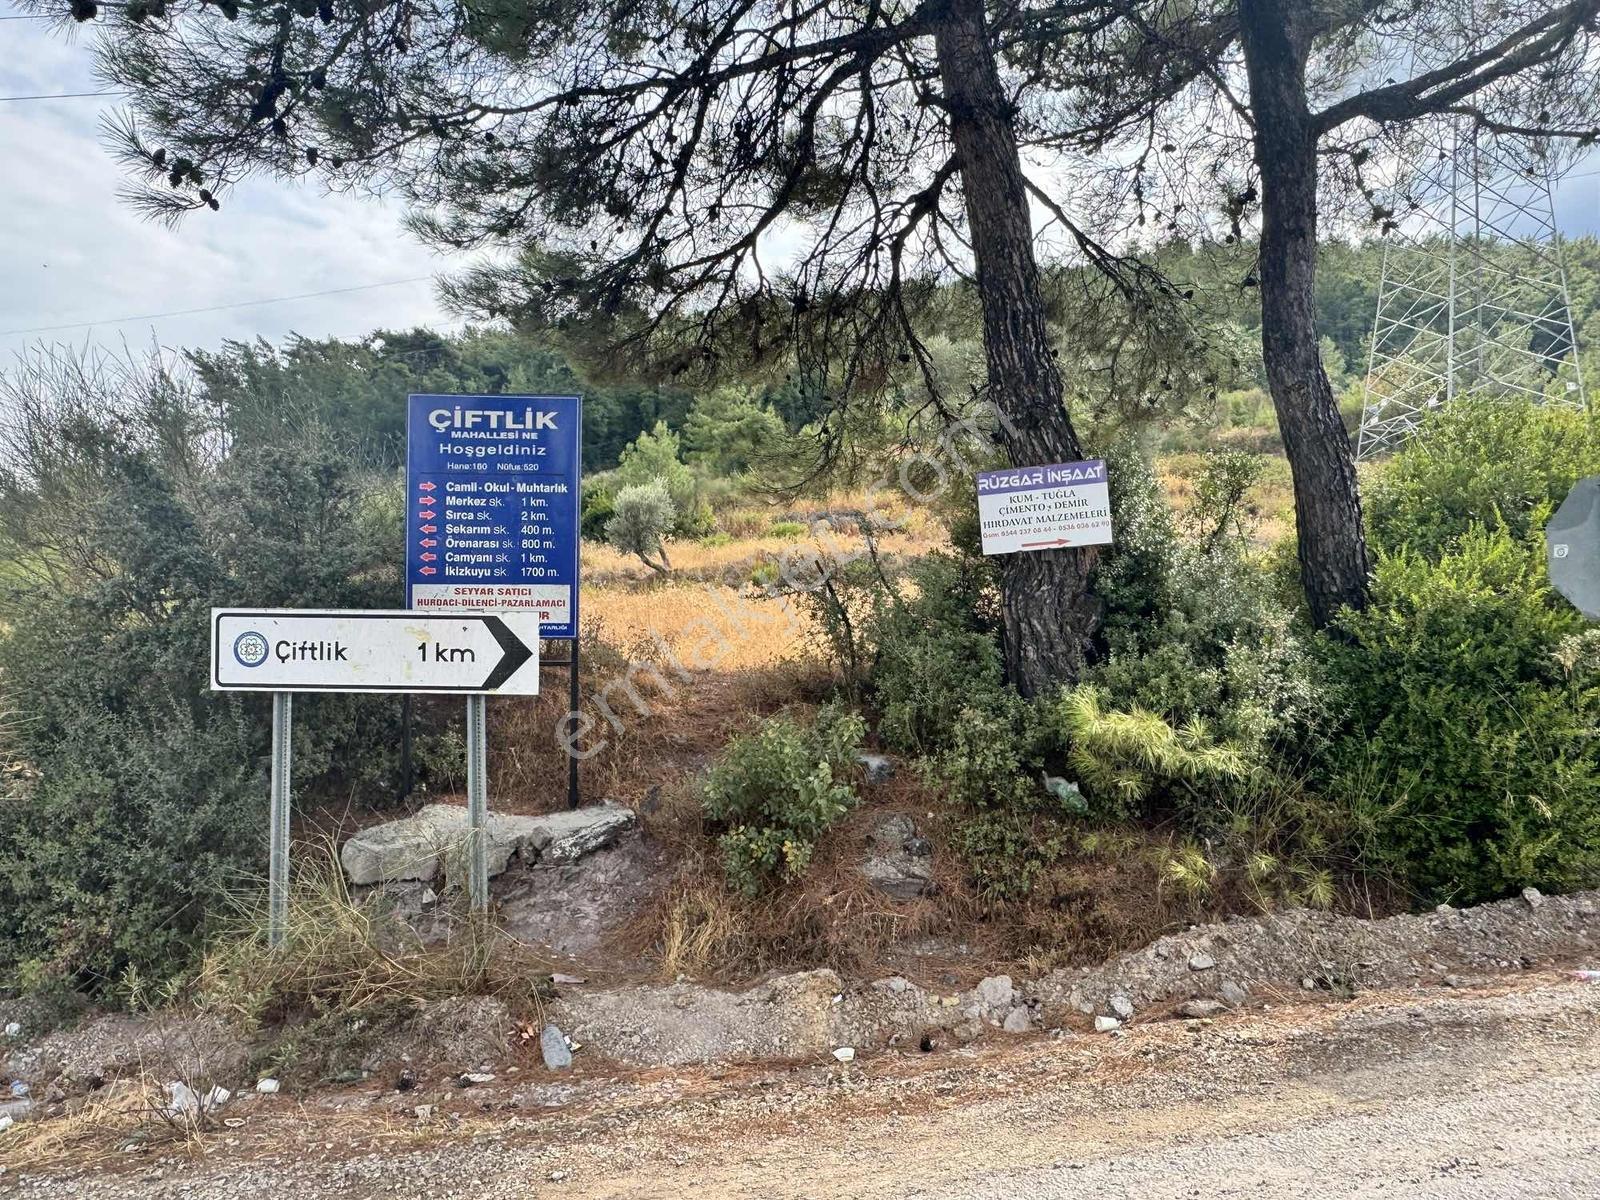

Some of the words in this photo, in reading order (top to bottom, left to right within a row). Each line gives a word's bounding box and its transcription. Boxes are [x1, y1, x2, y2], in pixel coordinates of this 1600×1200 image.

[428, 406, 558, 433] ÇİFTLİK
[451, 431, 519, 440] MAHALLESİ
[522, 432, 539, 440] NE
[439, 443, 547, 458] Hoşgeldiniz
[978, 473, 1044, 491] RÜZGAR
[1047, 466, 1103, 485] İNŞAAT
[484, 482, 510, 493] Okul
[516, 482, 568, 494] Muhtarlık
[446, 497, 487, 507] Merkez
[489, 497, 505, 508] sk.
[521, 498, 527, 507] 1
[530, 498, 549, 507] km.
[1009, 494, 1033, 504] KUM
[1042, 489, 1076, 500] TUĞLA
[998, 503, 1046, 517] ÇİMENTO
[1054, 498, 1089, 509] DEMİR
[446, 511, 474, 520] Sırca
[476, 511, 493, 521] sk.
[521, 512, 528, 521] 2
[530, 511, 549, 521] km.
[983, 517, 1034, 529] HIRDAVAT
[1036, 507, 1107, 524] MALZEMELERİ
[445, 524, 491, 534] Sekarım
[493, 525, 510, 535] sk.
[521, 525, 540, 535] 400
[542, 527, 555, 535] m.
[445, 536, 499, 548] Örenarası
[502, 539, 516, 549] sk.
[521, 539, 540, 549] 800
[543, 541, 556, 549] m.
[445, 552, 493, 564] Camyanı
[495, 553, 511, 563] sk.
[521, 553, 526, 563] 1
[529, 553, 548, 563] km.
[445, 564, 491, 578] İkizkuyu
[521, 567, 545, 577] 1700
[547, 569, 560, 577] m.
[454, 587, 494, 596] SEYYAR
[497, 587, 532, 596] SATICI
[275, 640, 348, 664] Çiftlik
[417, 642, 428, 662] 1
[435, 642, 475, 663] km
